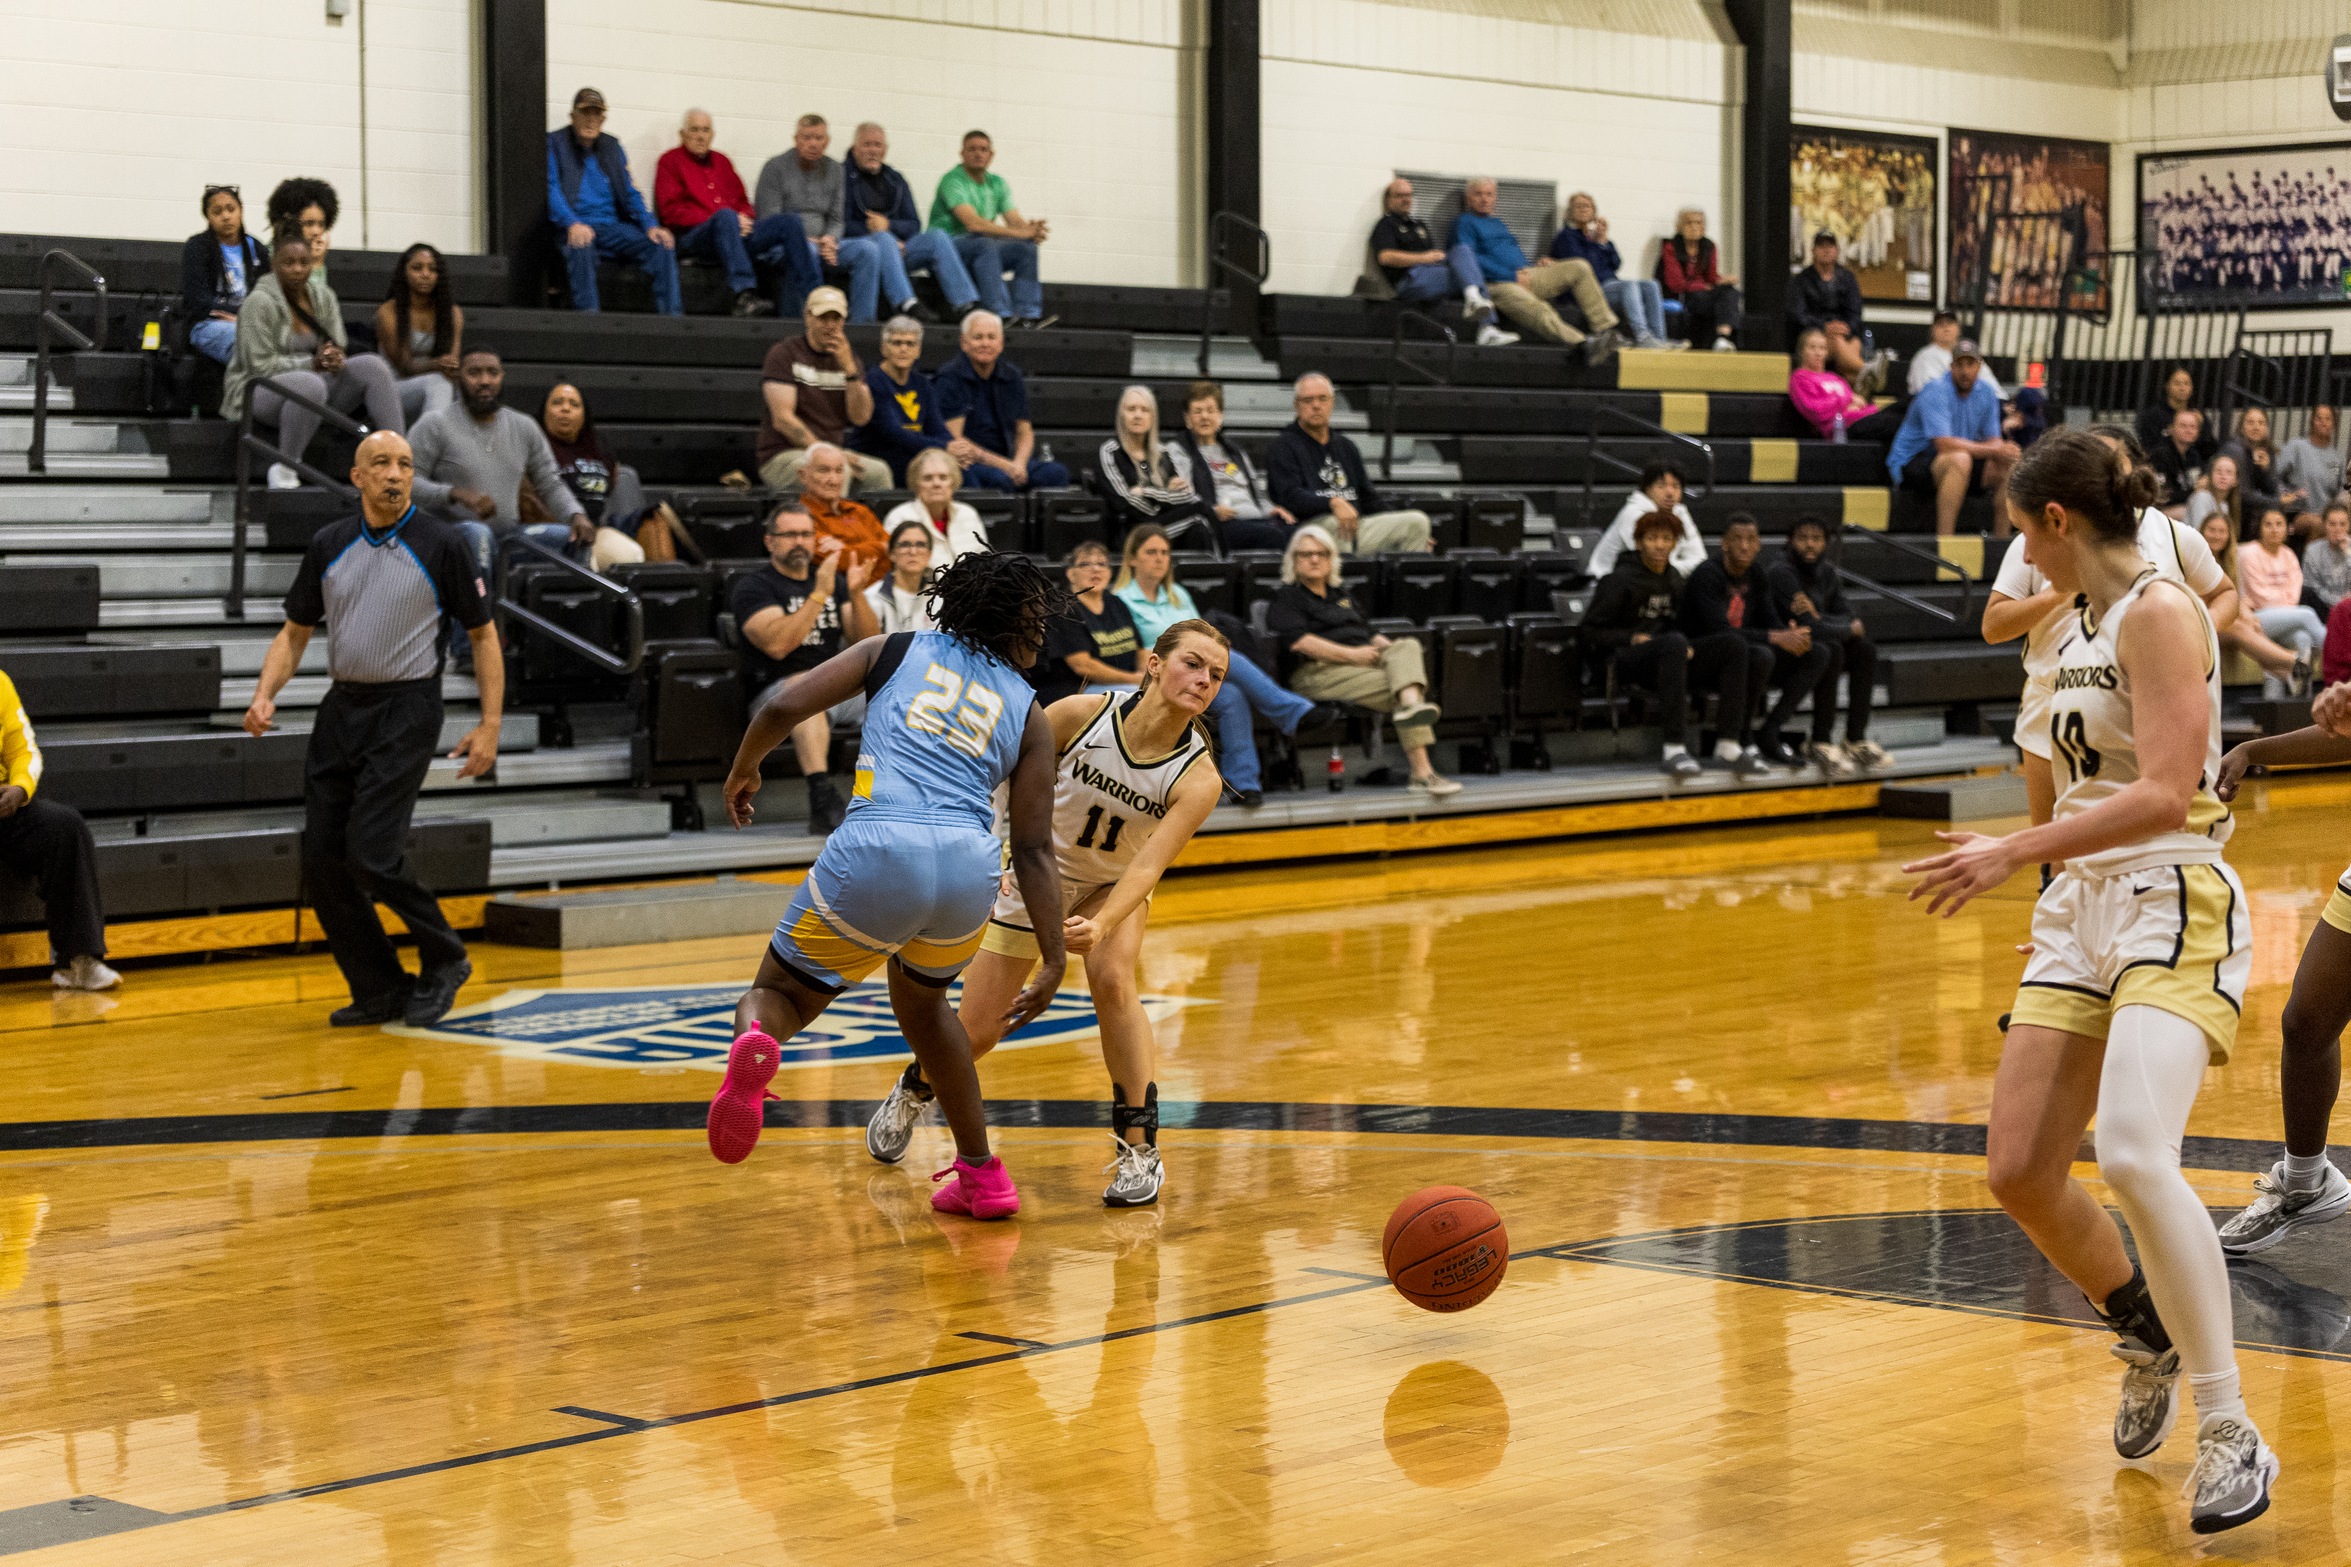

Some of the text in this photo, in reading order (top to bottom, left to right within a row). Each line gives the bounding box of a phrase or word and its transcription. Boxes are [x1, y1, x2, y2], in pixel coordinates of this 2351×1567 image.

[906, 661, 1004, 758] 23
[2051, 711, 2101, 782] 10
[1072, 757, 1167, 820] WARRIORS
[1076, 804, 1126, 852] 11
[1431, 1248, 1498, 1290] LEGACY
